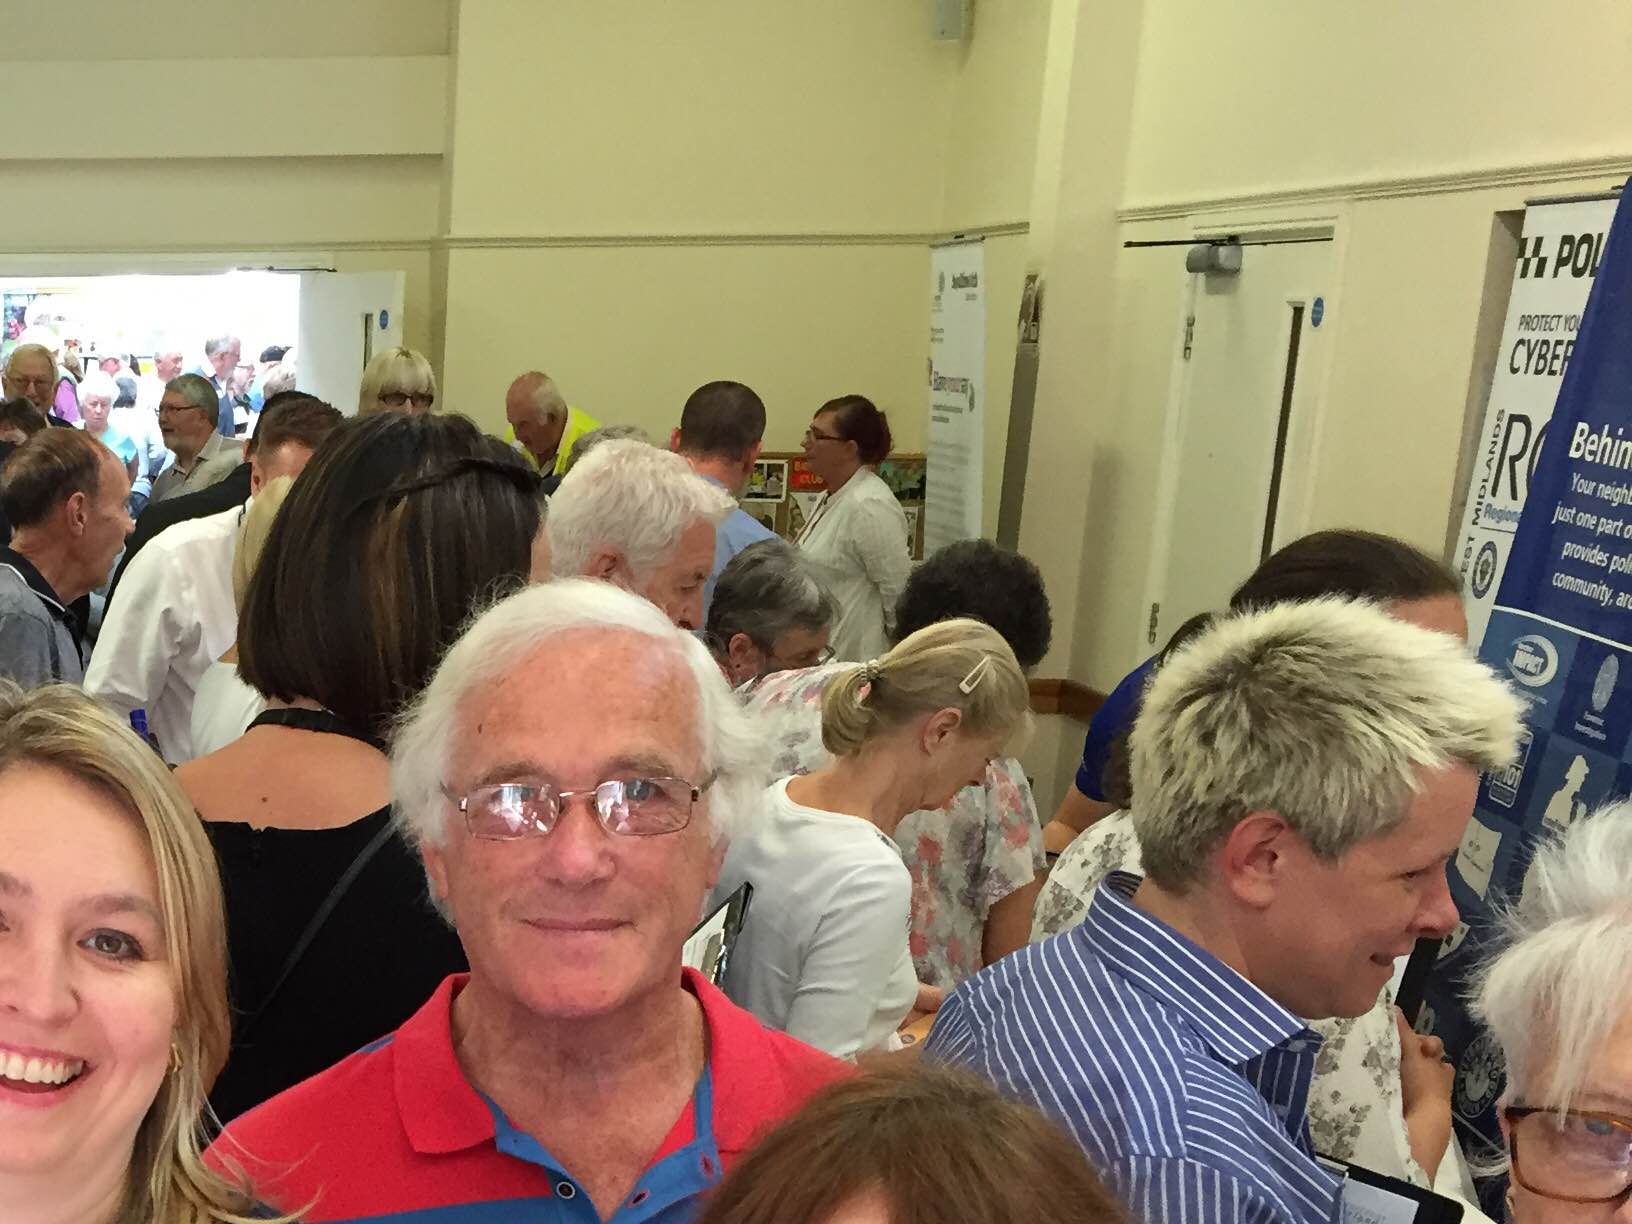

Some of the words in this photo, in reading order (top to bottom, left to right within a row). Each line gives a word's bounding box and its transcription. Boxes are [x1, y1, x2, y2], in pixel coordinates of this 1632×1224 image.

[1518, 314, 1562, 331] PROTECT
[1471, 409, 1505, 525] MIDLANDS
[1571, 472, 1596, 495] Your
[1551, 501, 1576, 524] just
[1576, 511, 1597, 530] one
[1596, 517, 1623, 536] part
[1560, 542, 1609, 567] provides
[1552, 572, 1614, 606] community,
